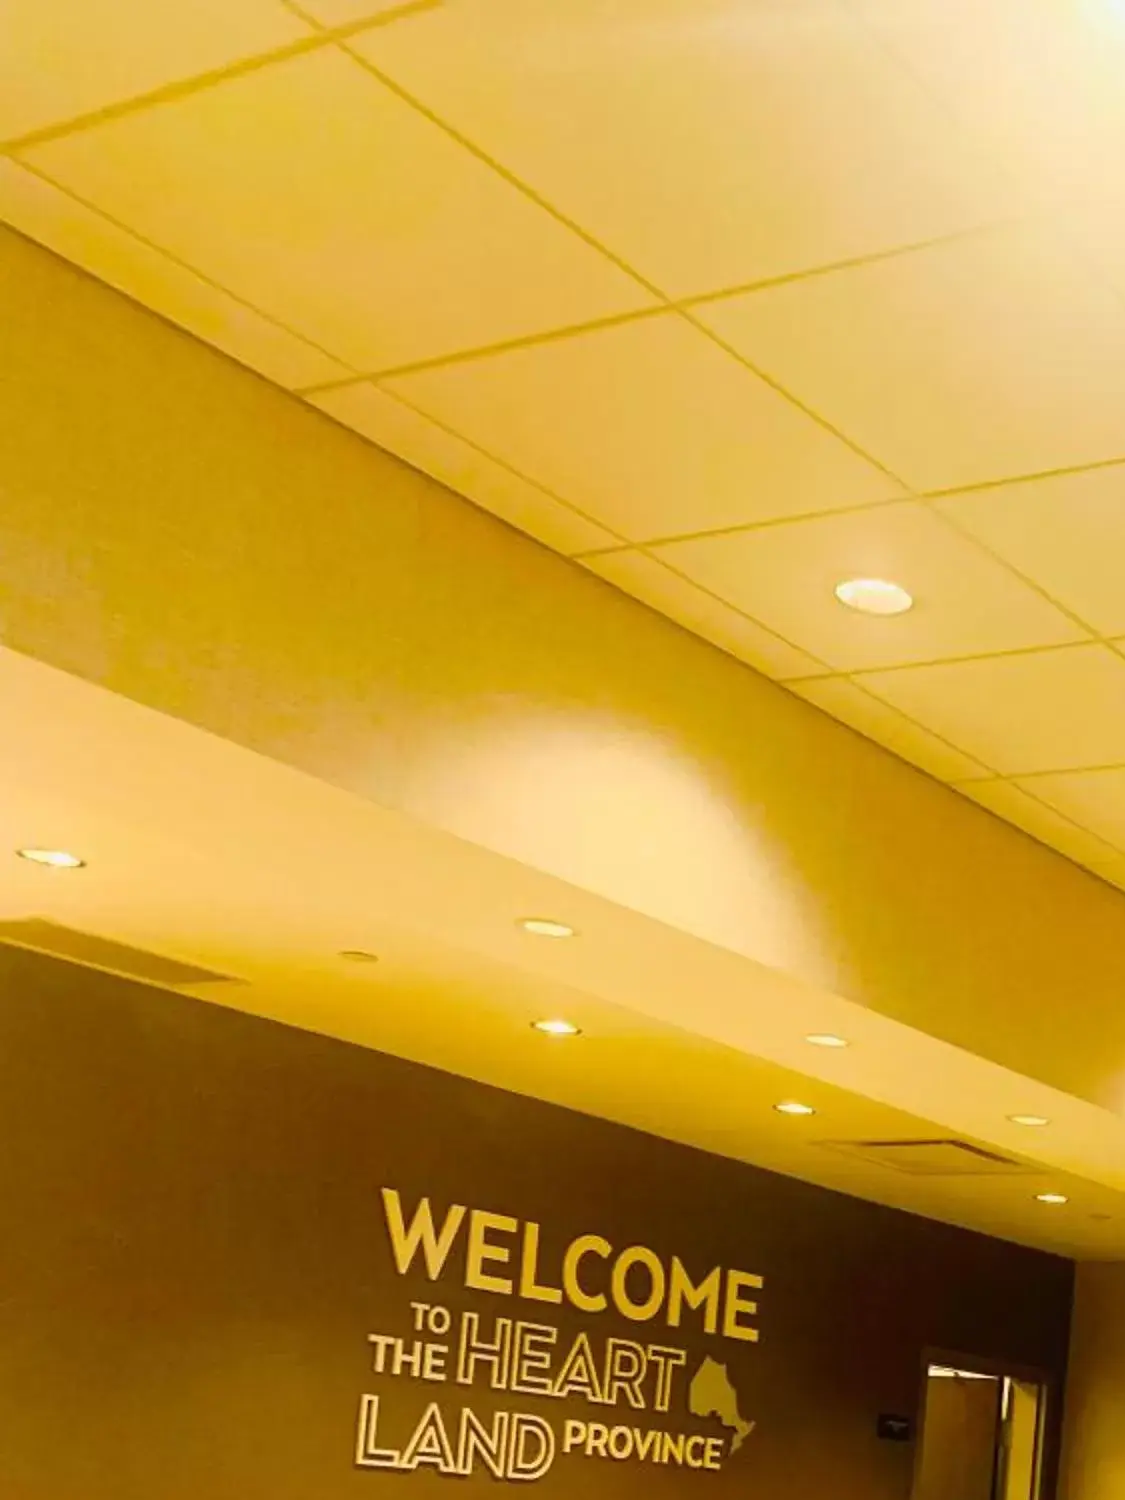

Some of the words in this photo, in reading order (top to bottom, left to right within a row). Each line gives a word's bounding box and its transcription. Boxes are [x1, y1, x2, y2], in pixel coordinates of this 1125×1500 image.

[381, 1187, 765, 1343] WELCOME
[368, 1333, 448, 1382] THE
[457, 1311, 687, 1413] HEART
[410, 1301, 450, 1335] TO
[355, 1393, 556, 1481] LAND
[562, 1420, 724, 1470] PROVINCE
